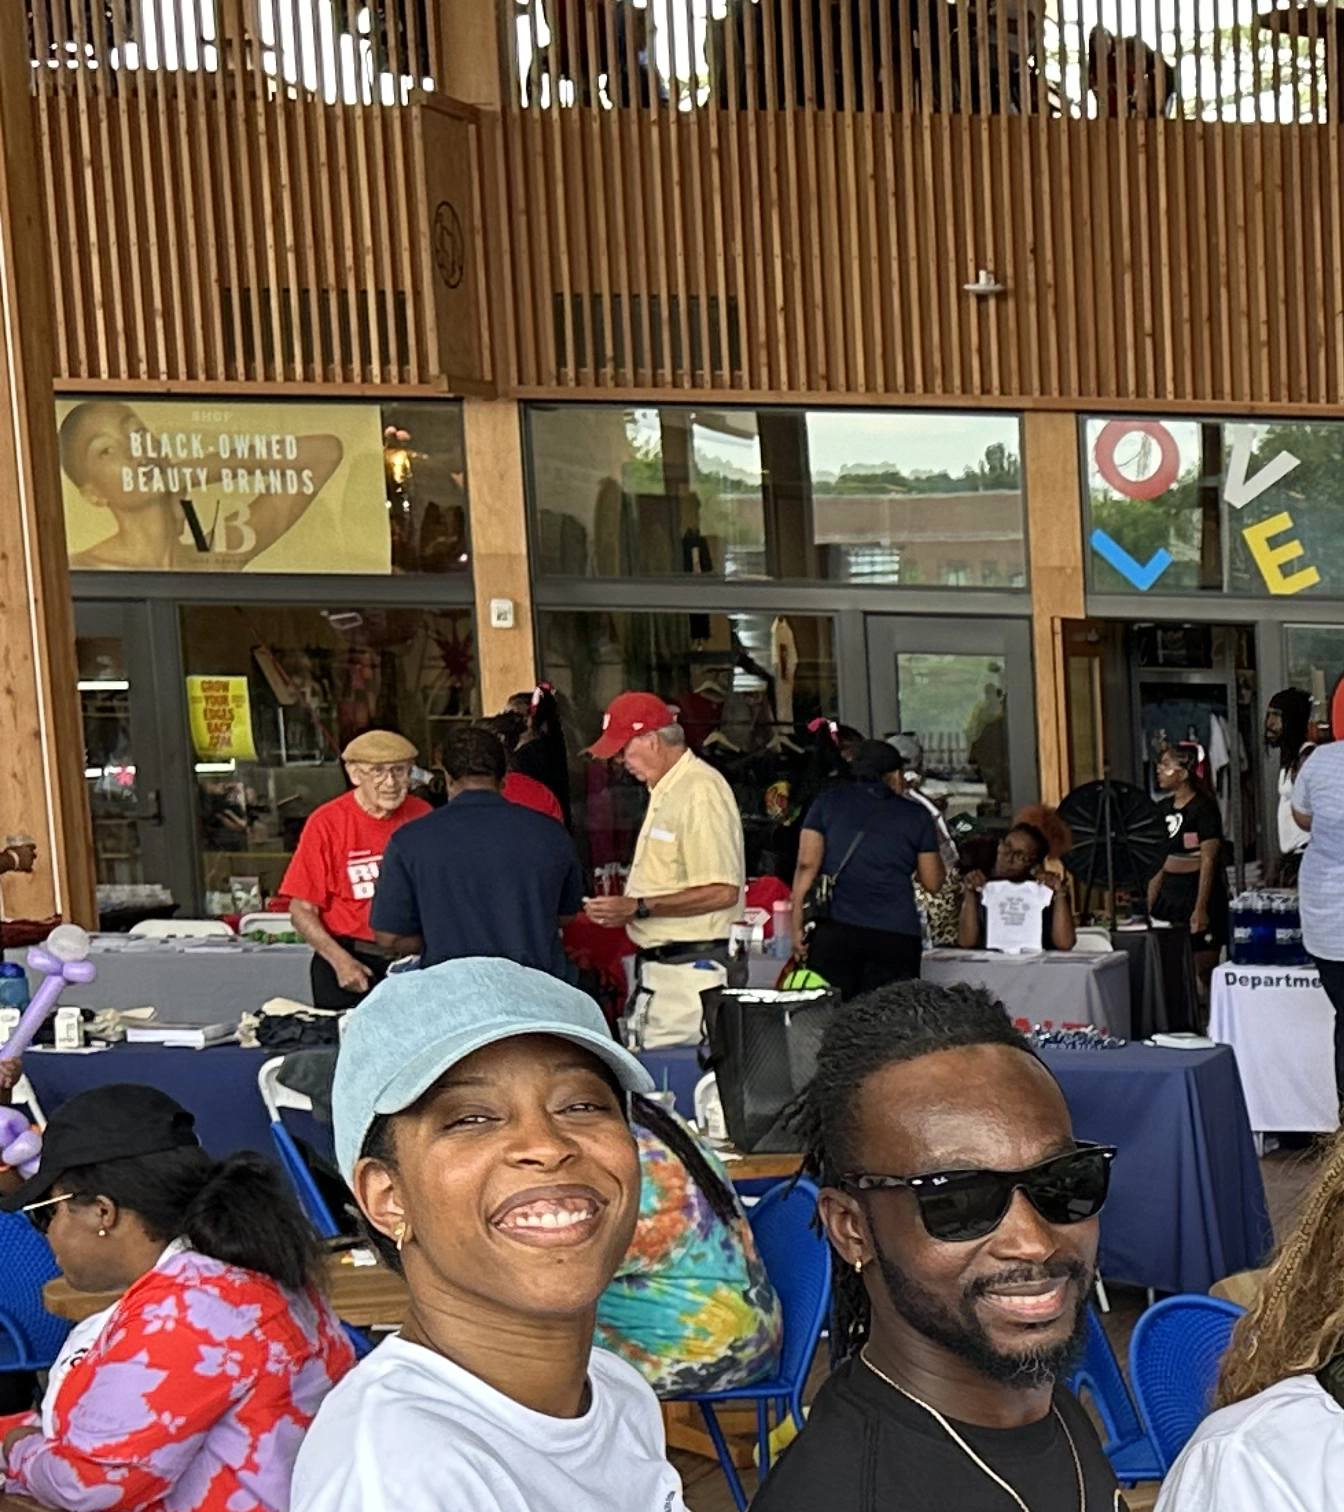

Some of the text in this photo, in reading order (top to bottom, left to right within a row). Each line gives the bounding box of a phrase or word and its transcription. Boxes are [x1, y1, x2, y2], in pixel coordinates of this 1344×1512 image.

[130, 431, 298, 460] BLACK-OWNED
[121, 466, 315, 495] BEAUTY BRANDS
[1225, 972, 1322, 990] Departme
